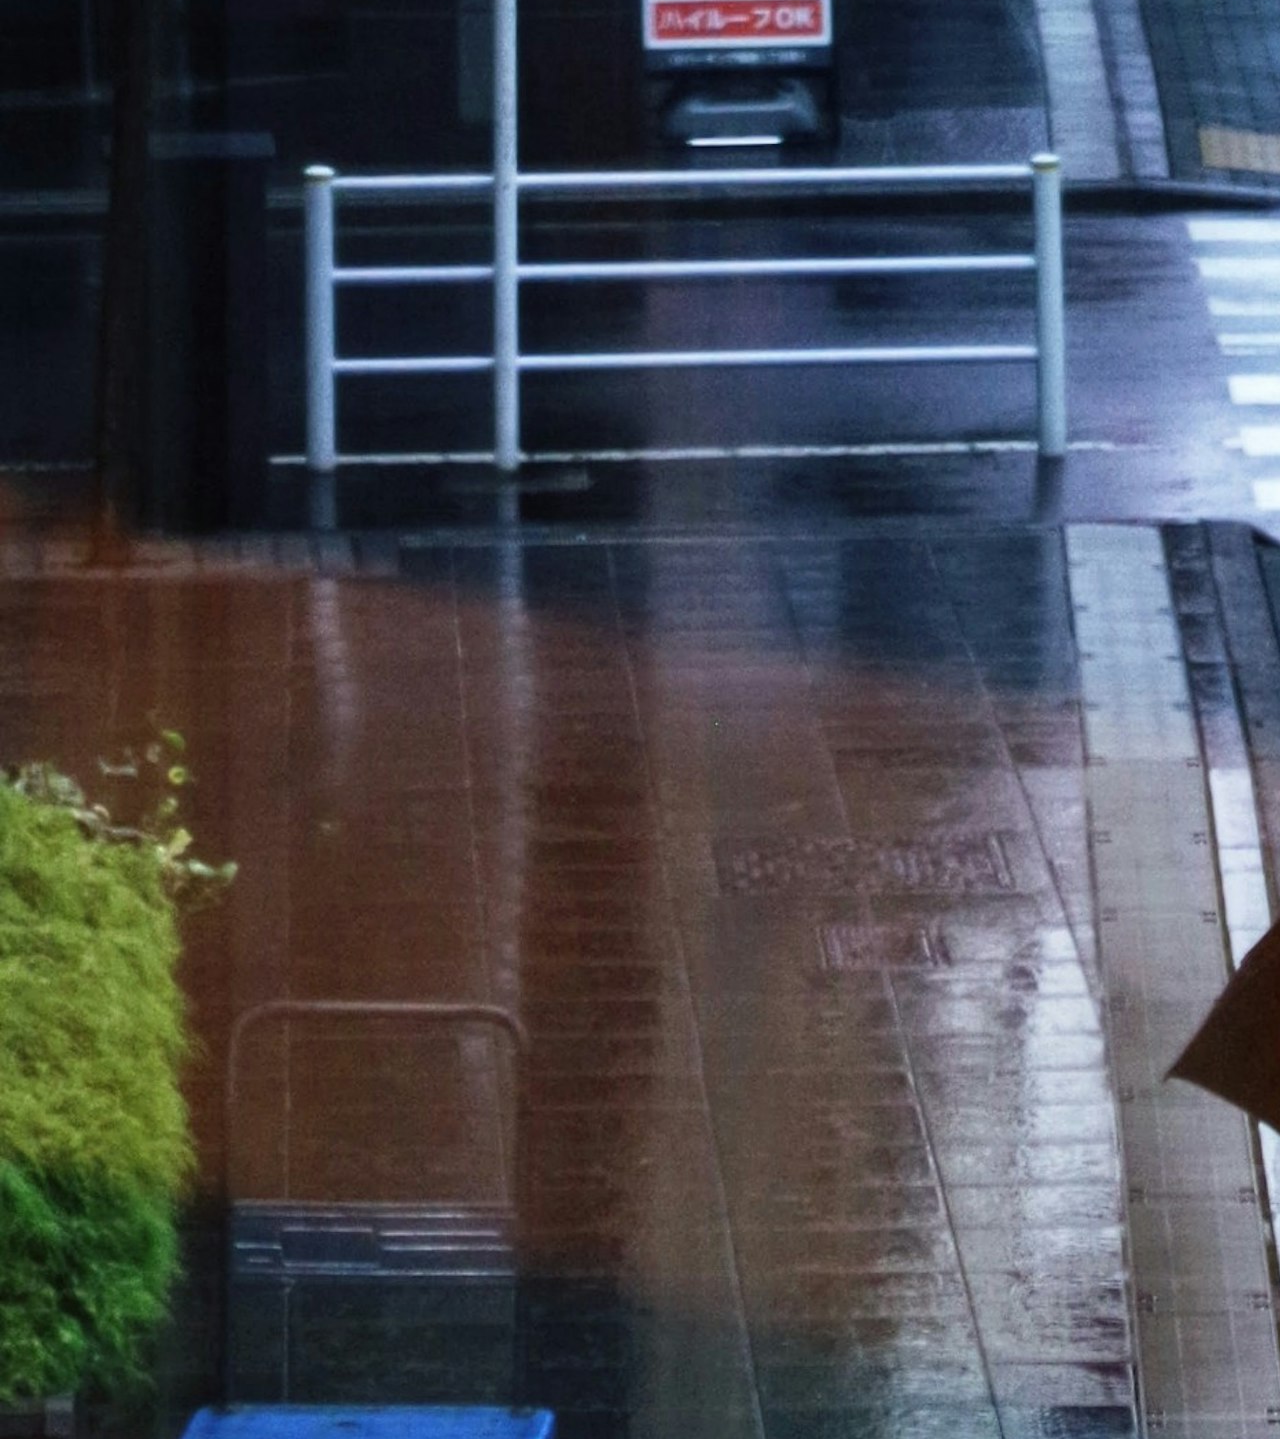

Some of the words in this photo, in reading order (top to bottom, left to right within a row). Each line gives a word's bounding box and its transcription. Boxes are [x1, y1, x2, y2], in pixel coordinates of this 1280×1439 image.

[657, 7, 815, 31] ハイルーフOK
